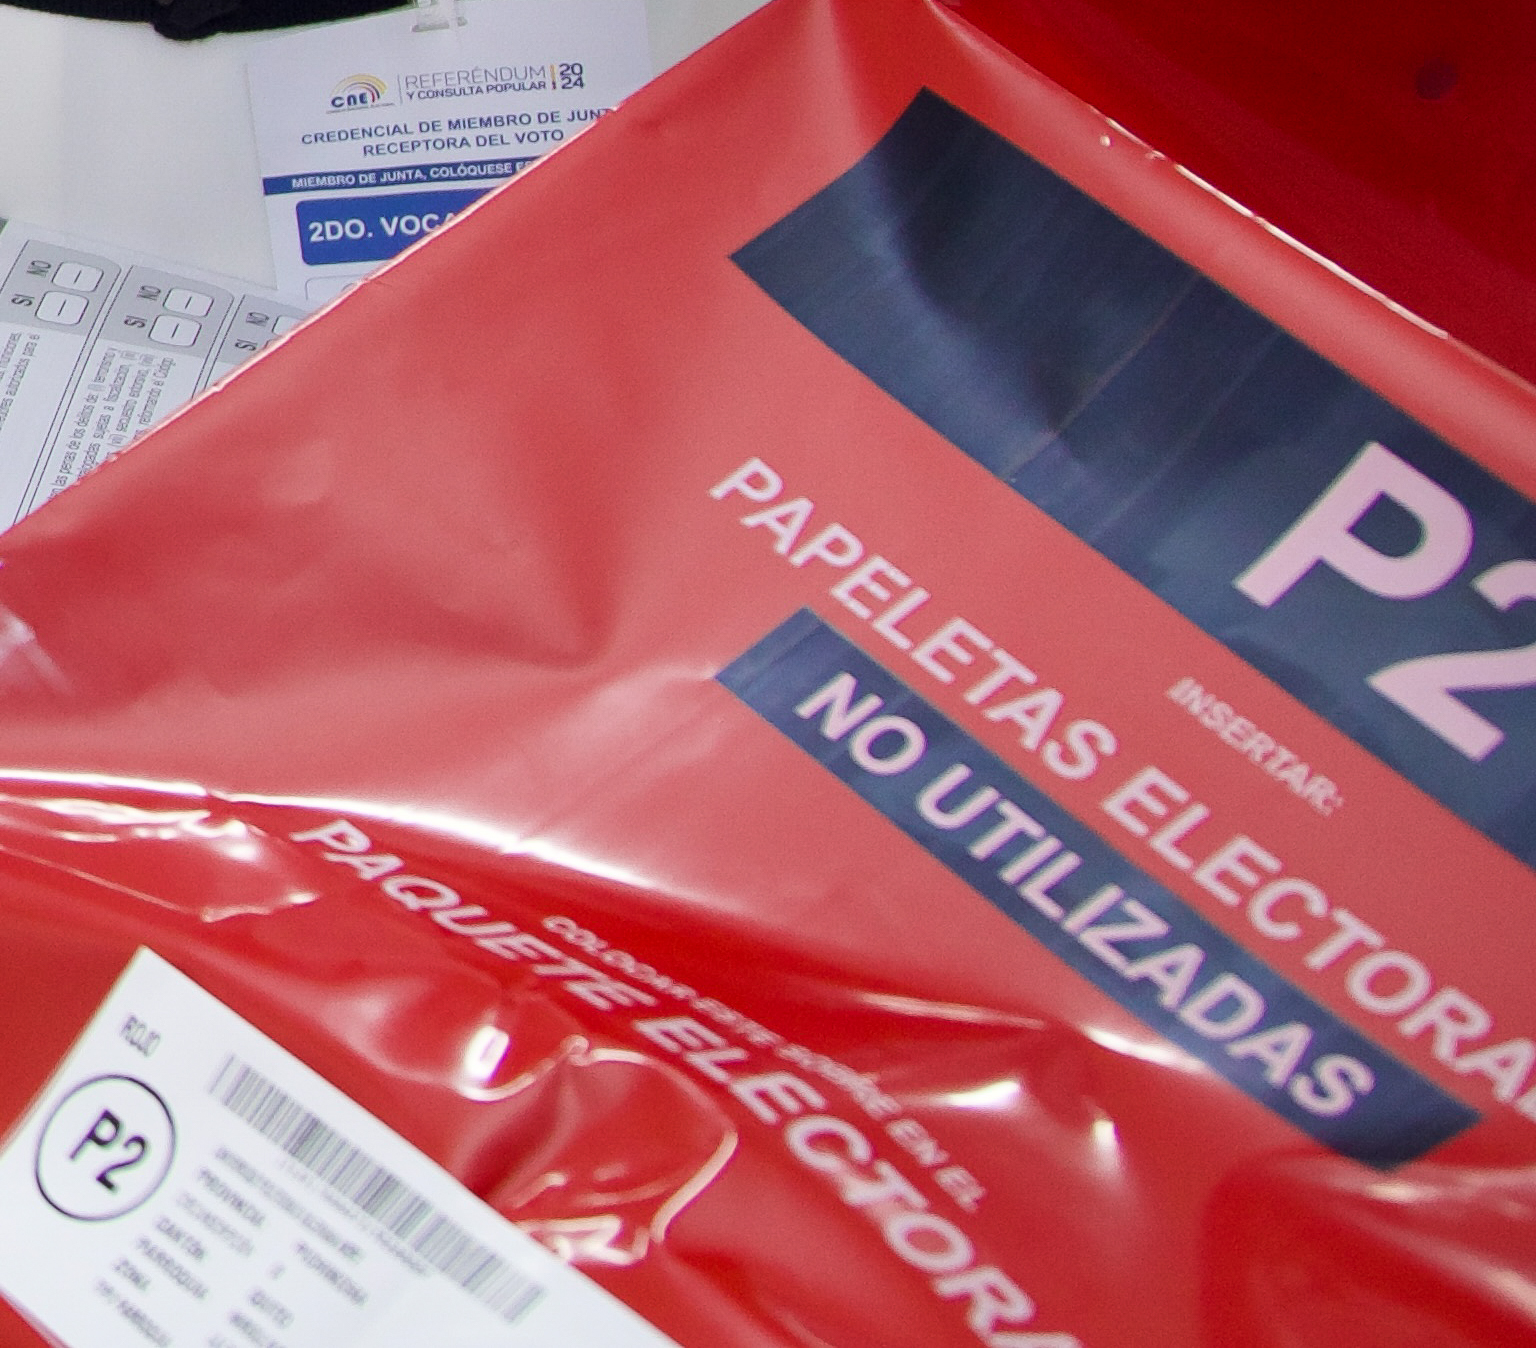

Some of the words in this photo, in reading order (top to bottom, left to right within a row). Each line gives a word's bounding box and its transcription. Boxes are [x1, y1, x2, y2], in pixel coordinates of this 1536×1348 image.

[404, 65, 547, 92] REFERÉNDUM
[558, 62, 584, 78] 20
[406, 90, 415, 101] Y
[417, 84, 484, 100] CONSULTA
[485, 79, 547, 94] POPULAR
[560, 75, 585, 90] 24
[301, 123, 411, 147] CREDENCIAL
[418, 120, 442, 133] DE
[447, 113, 532, 131] MIEMBRO
[537, 111, 561, 124] DE
[363, 136, 472, 157] RECEPTORA
[476, 134, 511, 148] DEL
[515, 129, 564, 144] VOTO
[292, 172, 358, 190] MIEMBRO
[358, 172, 377, 185] DE
[380, 167, 430, 185] JUNTA,
[429, 160, 514, 181] COLÓQUESE
[308, 218, 373, 243] 2DO.
[10, 293, 35, 307] SI
[26, 260, 52, 277] NO
[1232, 440, 1536, 762] P2
[1166, 676, 1343, 816] INSERTAR:
[708, 456, 1116, 780] PAPELETAS
[1098, 764, 1536, 1120] ELECTORA
[794, 672, 925, 775] NO
[915, 763, 1374, 1115] UTILIZADAS
[290, 817, 657, 1011] PAQUETE
[631, 1016, 1082, 1348] ELECTOR
[64, 1106, 155, 1198] P2
[885, 1117, 950, 1168] EN
